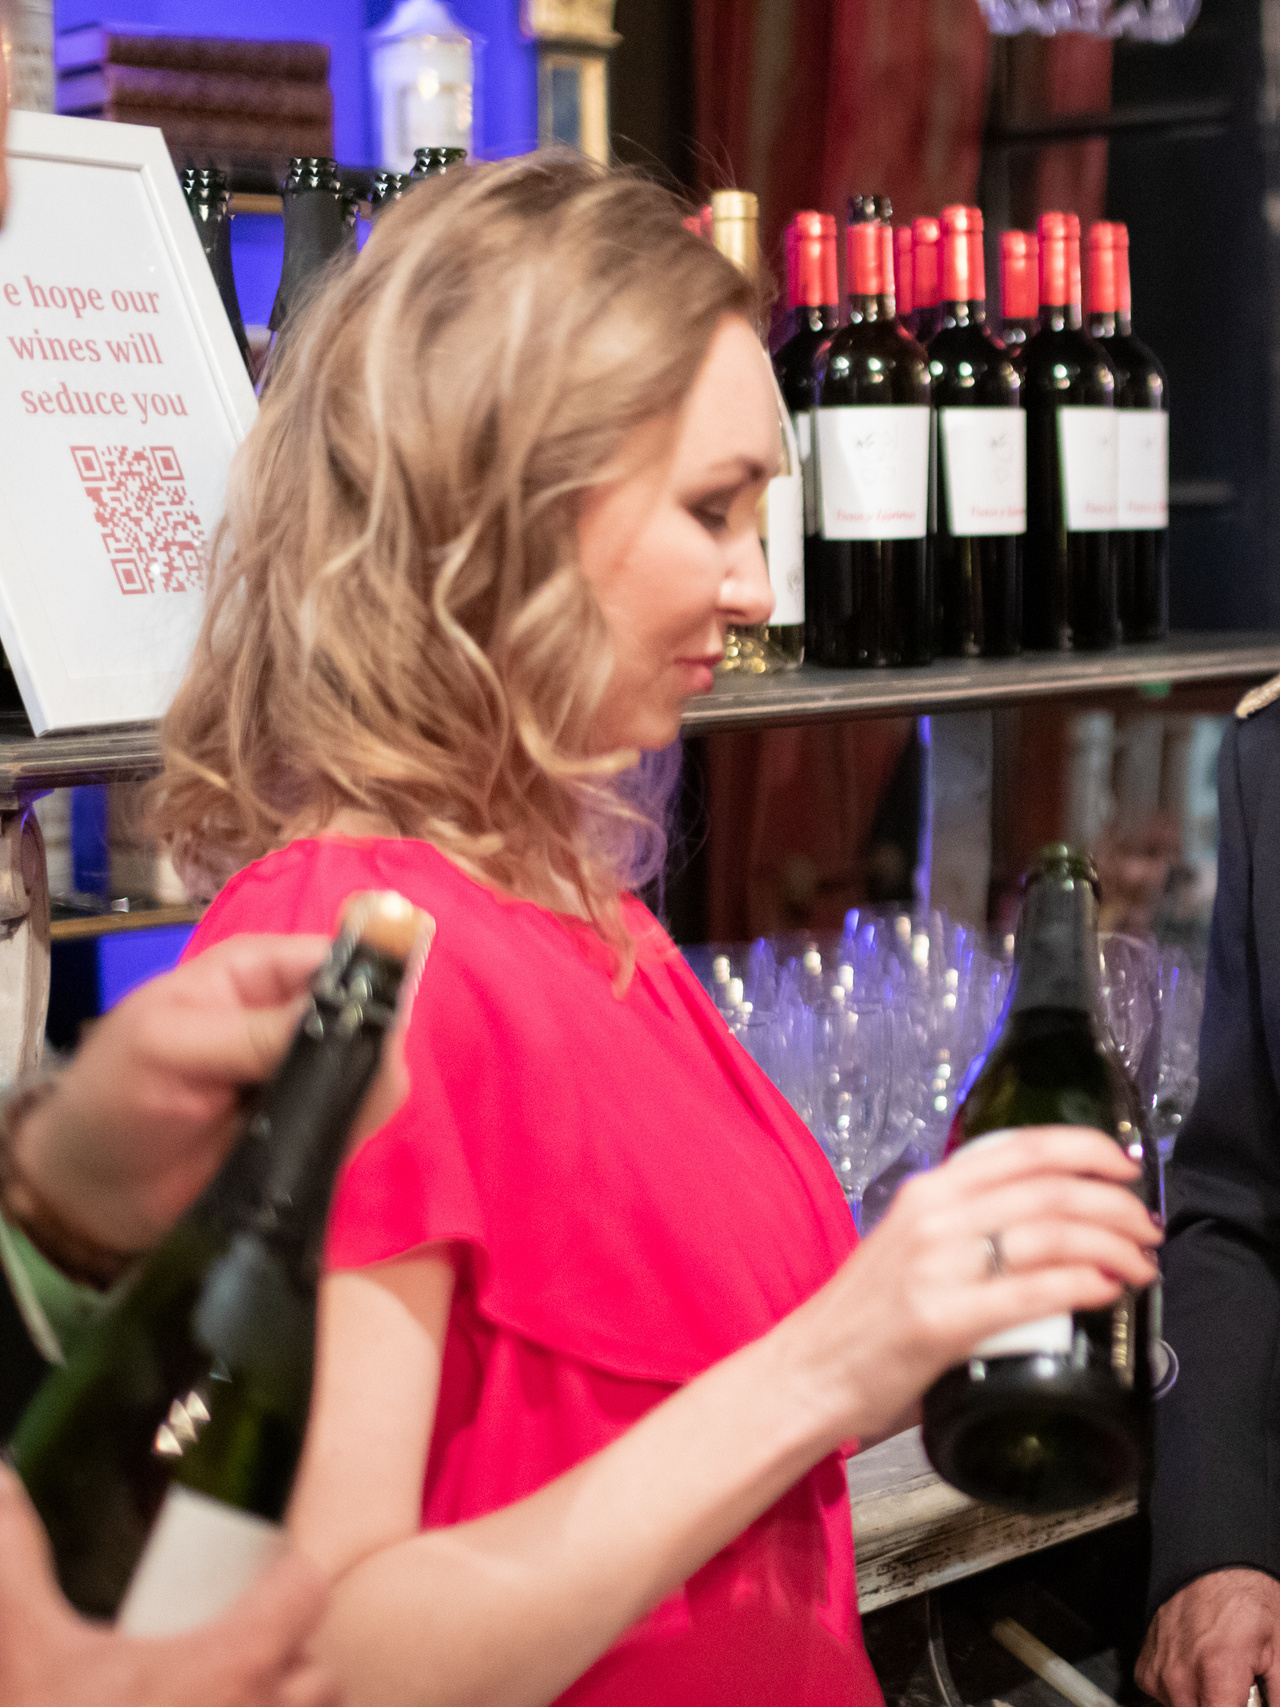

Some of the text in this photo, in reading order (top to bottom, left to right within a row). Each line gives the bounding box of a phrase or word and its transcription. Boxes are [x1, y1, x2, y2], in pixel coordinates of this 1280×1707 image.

[2, 275, 160, 319] e hope our
[6, 328, 164, 365] wines will
[20, 381, 189, 425] seduce you
